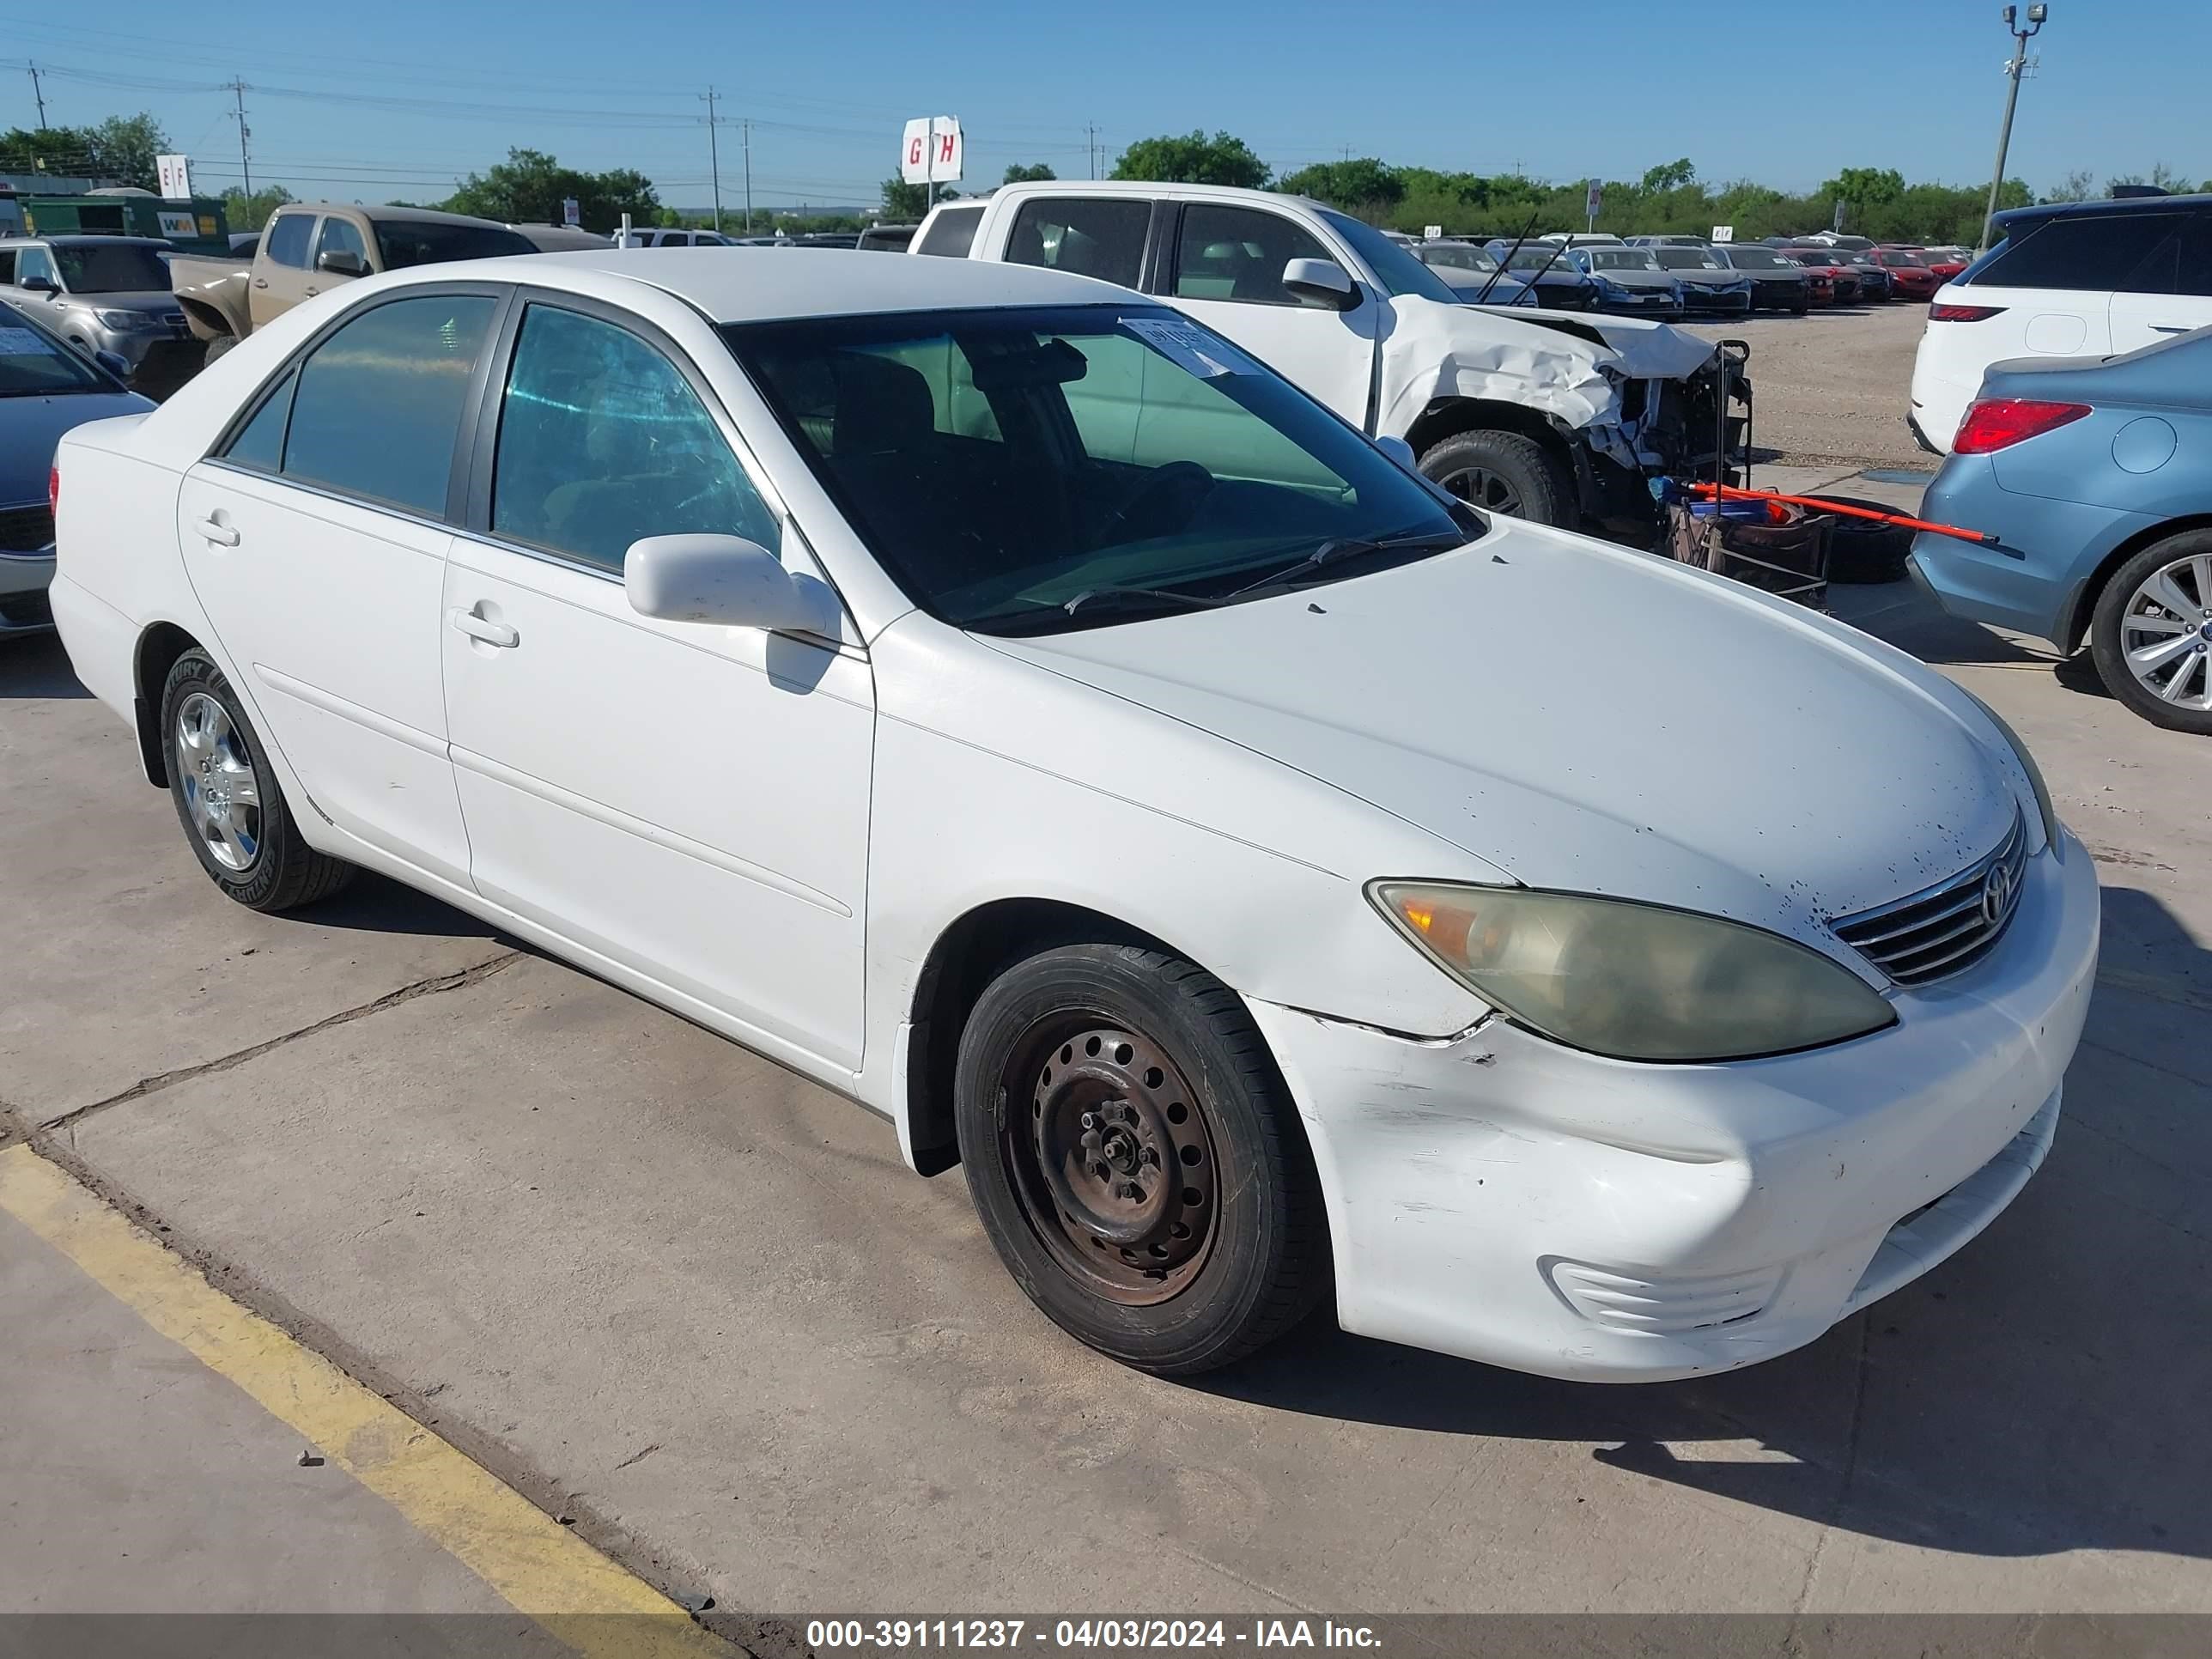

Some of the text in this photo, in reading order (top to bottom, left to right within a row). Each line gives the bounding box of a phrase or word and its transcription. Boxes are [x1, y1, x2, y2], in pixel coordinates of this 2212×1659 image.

[910, 134, 954, 165] G H
[163, 167, 183, 186] E F
[163, 219, 193, 231] WM
